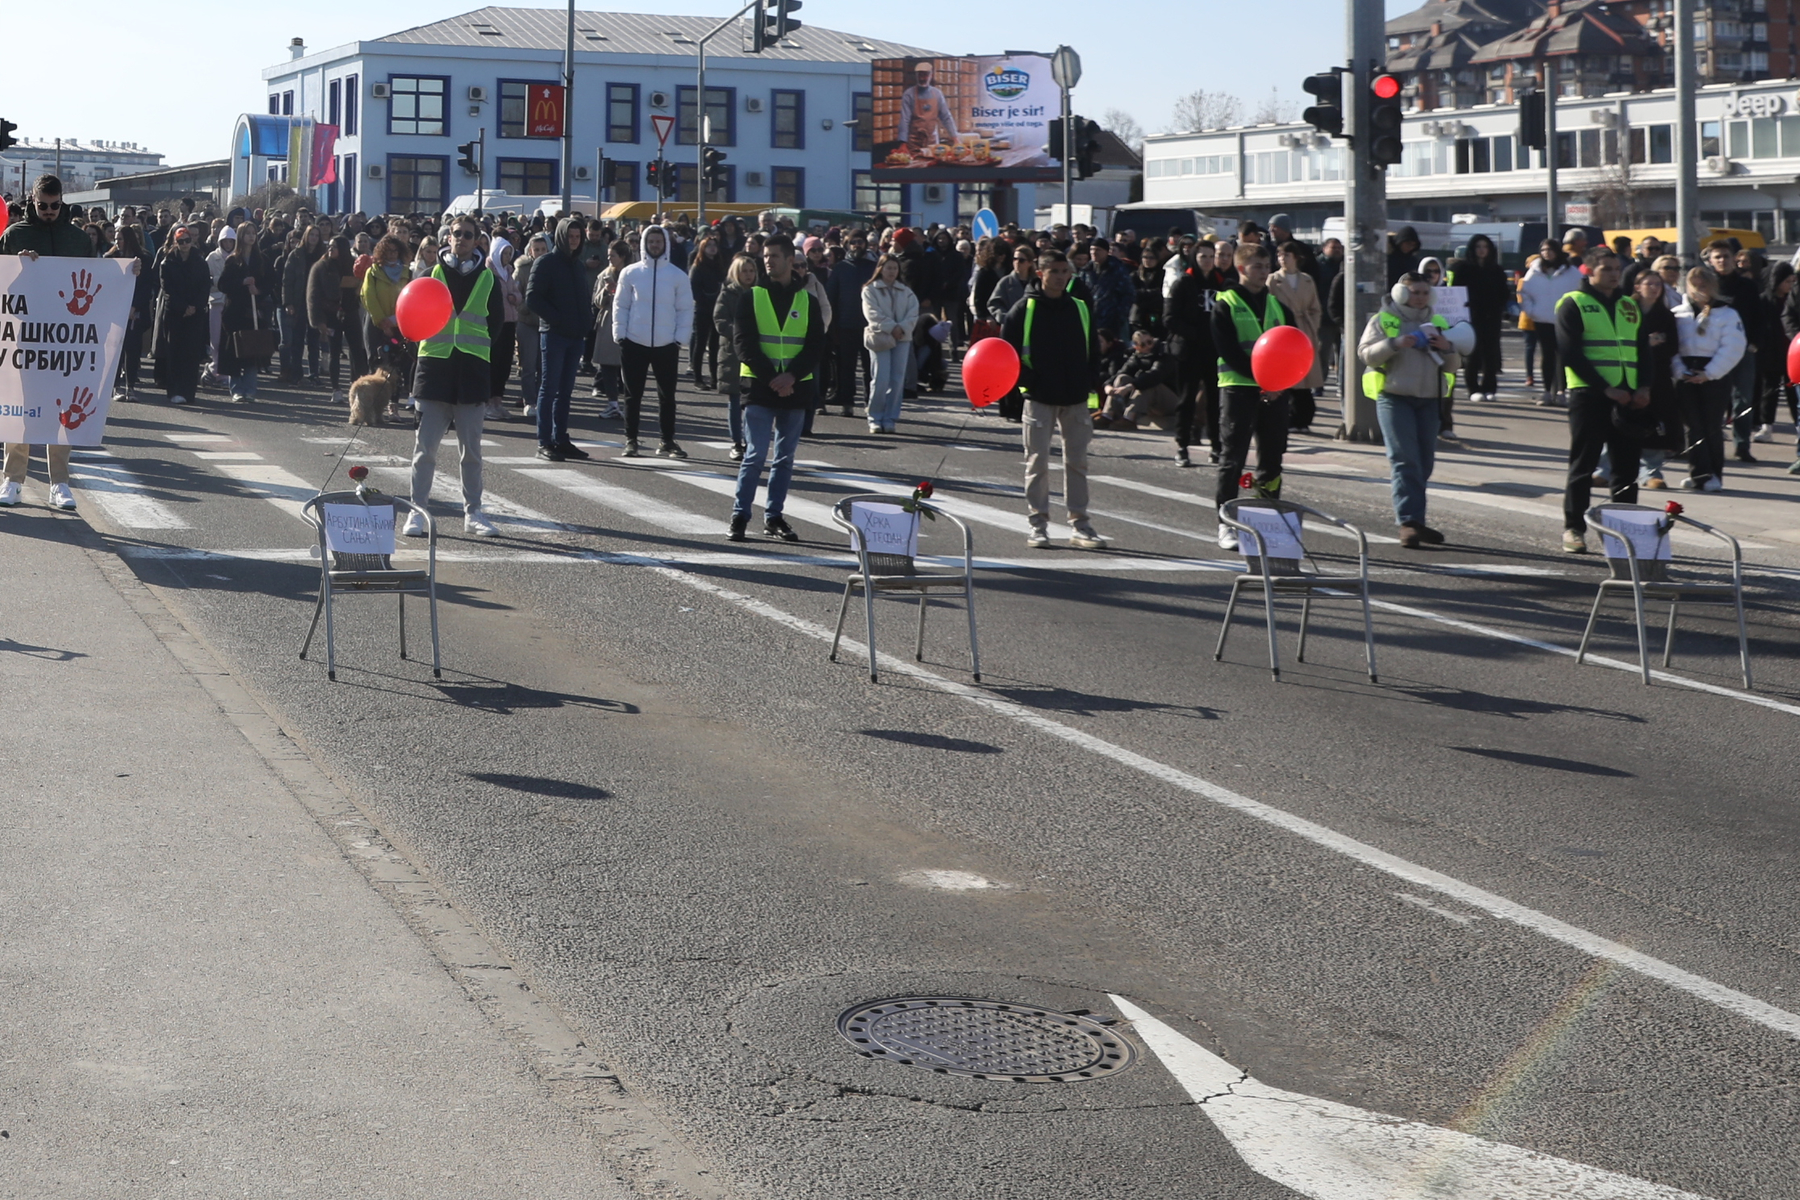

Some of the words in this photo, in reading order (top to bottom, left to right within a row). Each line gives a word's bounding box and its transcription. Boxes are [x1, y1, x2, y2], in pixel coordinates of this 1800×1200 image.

[986, 73, 1029, 85] BISER
[971, 107, 1005, 118] Biser
[1007, 105, 1020, 119] je
[1022, 106, 1045, 117] sir!
[20, 321, 99, 344] ШКОЛА
[11, 348, 87, 377] СРБИЈУ
[326, 511, 370, 530] АРБУТИНА
[863, 511, 891, 530] ХРКА
[342, 528, 372, 544] САЊА
